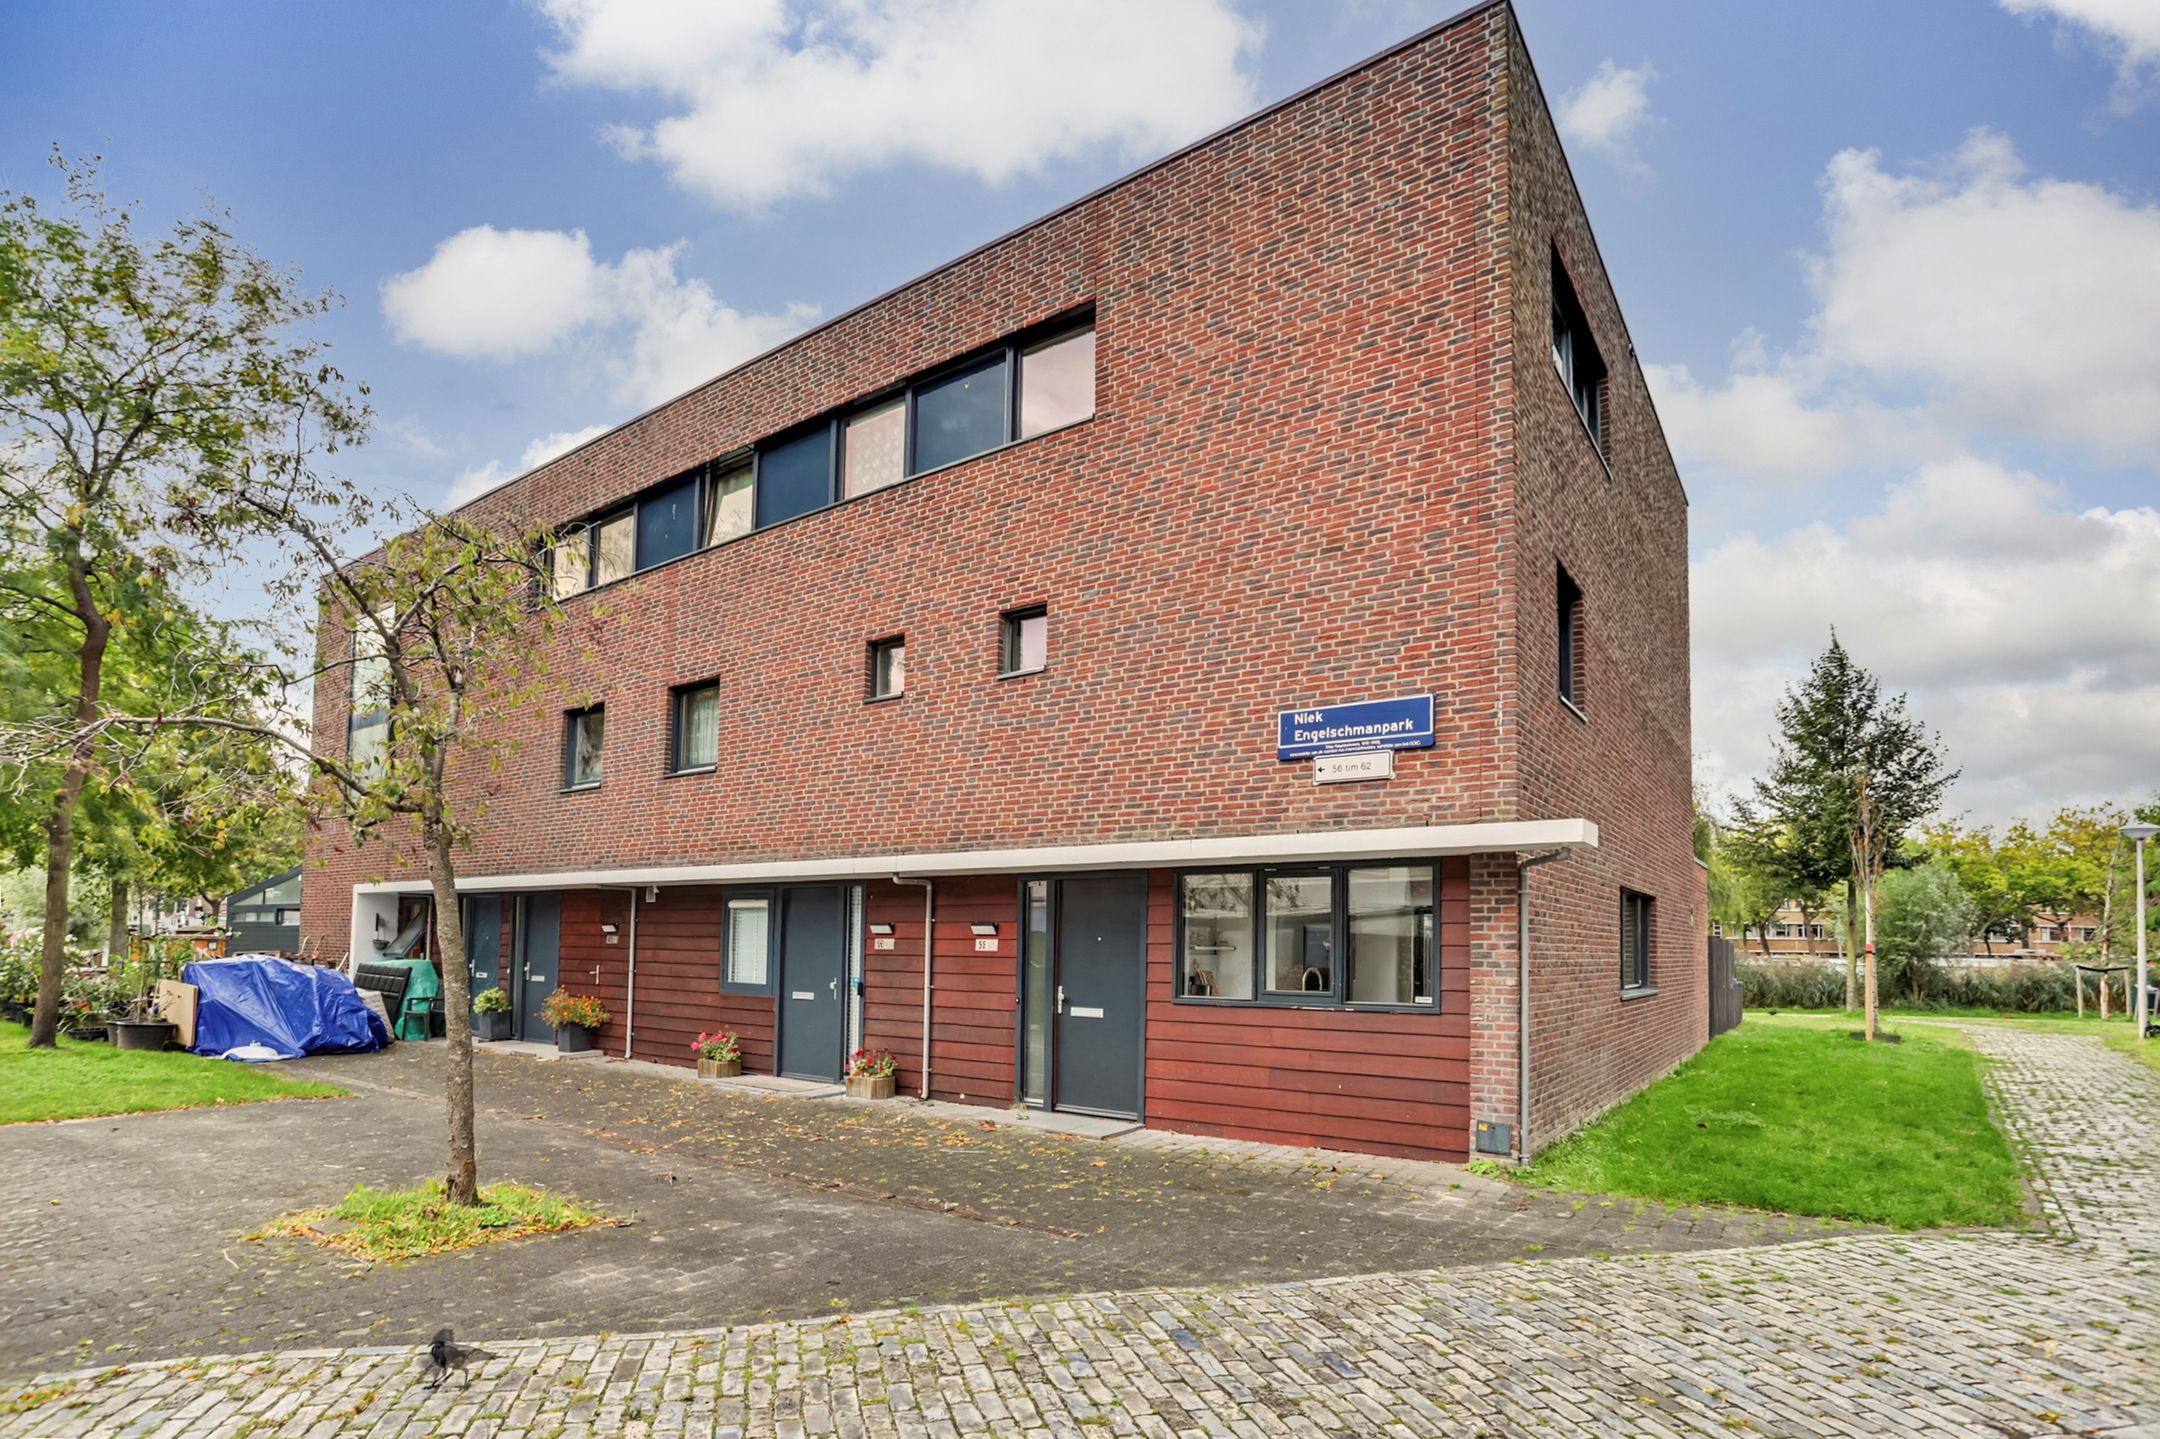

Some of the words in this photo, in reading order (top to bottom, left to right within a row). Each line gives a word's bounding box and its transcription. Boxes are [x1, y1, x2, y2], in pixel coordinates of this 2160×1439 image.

[1294, 711, 1323, 725] Niek
[1294, 718, 1414, 743] Engelschmanpark
[1360, 761, 1372, 771] 62
